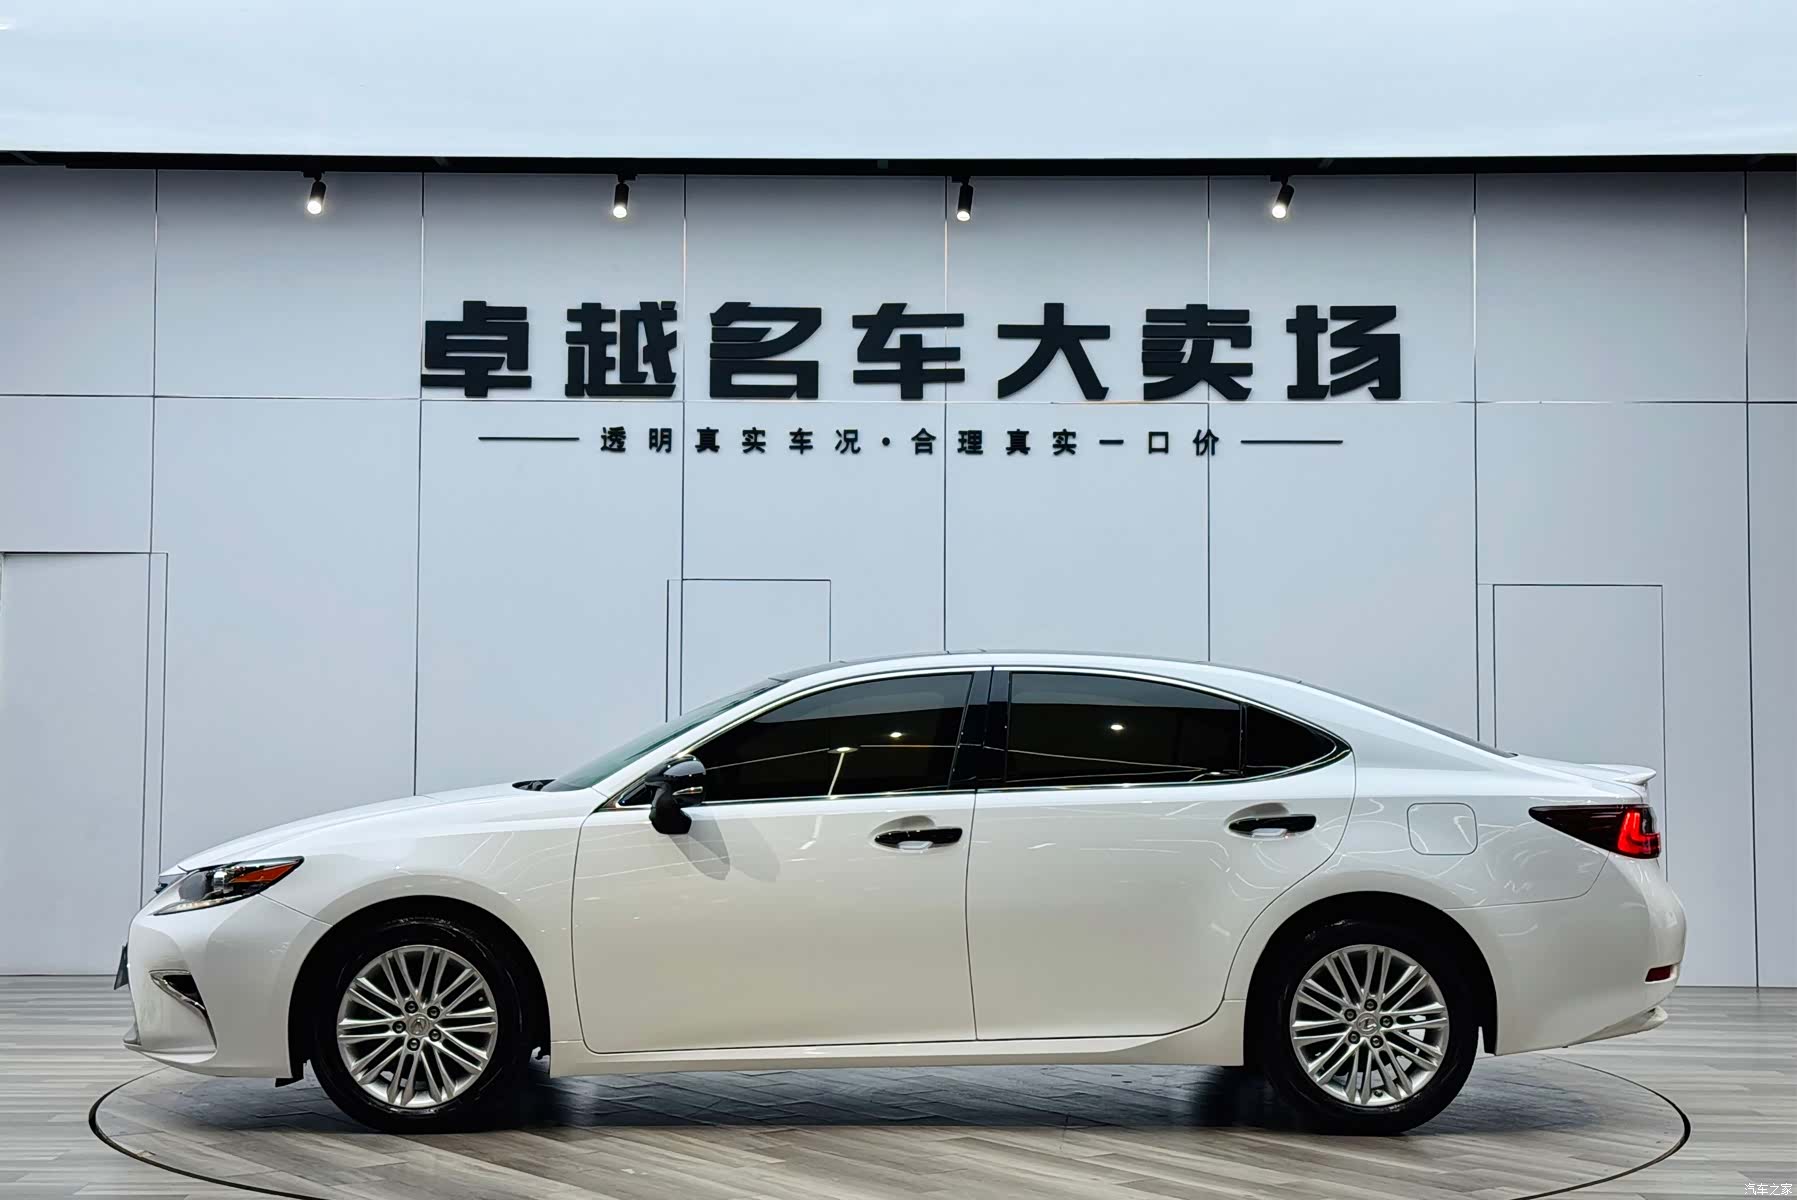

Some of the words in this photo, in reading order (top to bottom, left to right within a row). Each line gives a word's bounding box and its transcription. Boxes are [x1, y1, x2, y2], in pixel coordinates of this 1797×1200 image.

[421, 300, 1401, 400] 卓越名车大卖场
